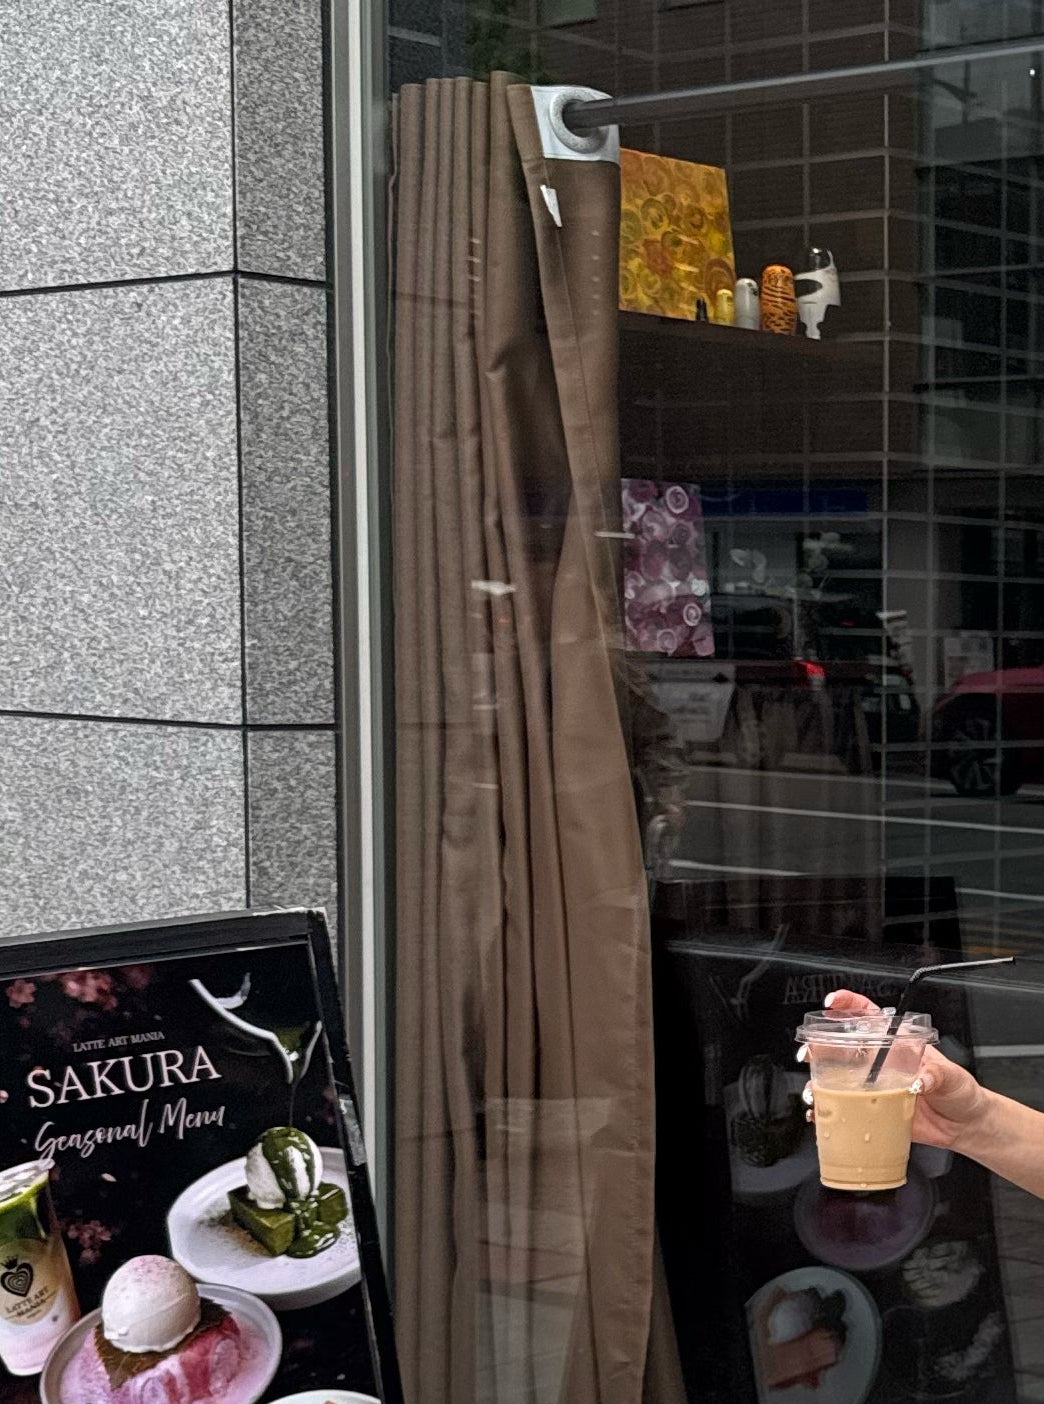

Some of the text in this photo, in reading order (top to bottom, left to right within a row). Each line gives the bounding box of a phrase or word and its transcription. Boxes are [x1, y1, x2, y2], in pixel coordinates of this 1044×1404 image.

[73, 1031, 165, 1053] LATTE ART MANIA
[26, 1045, 222, 1108] SAKURA
[34, 1097, 226, 1161] Seasonal Menu
